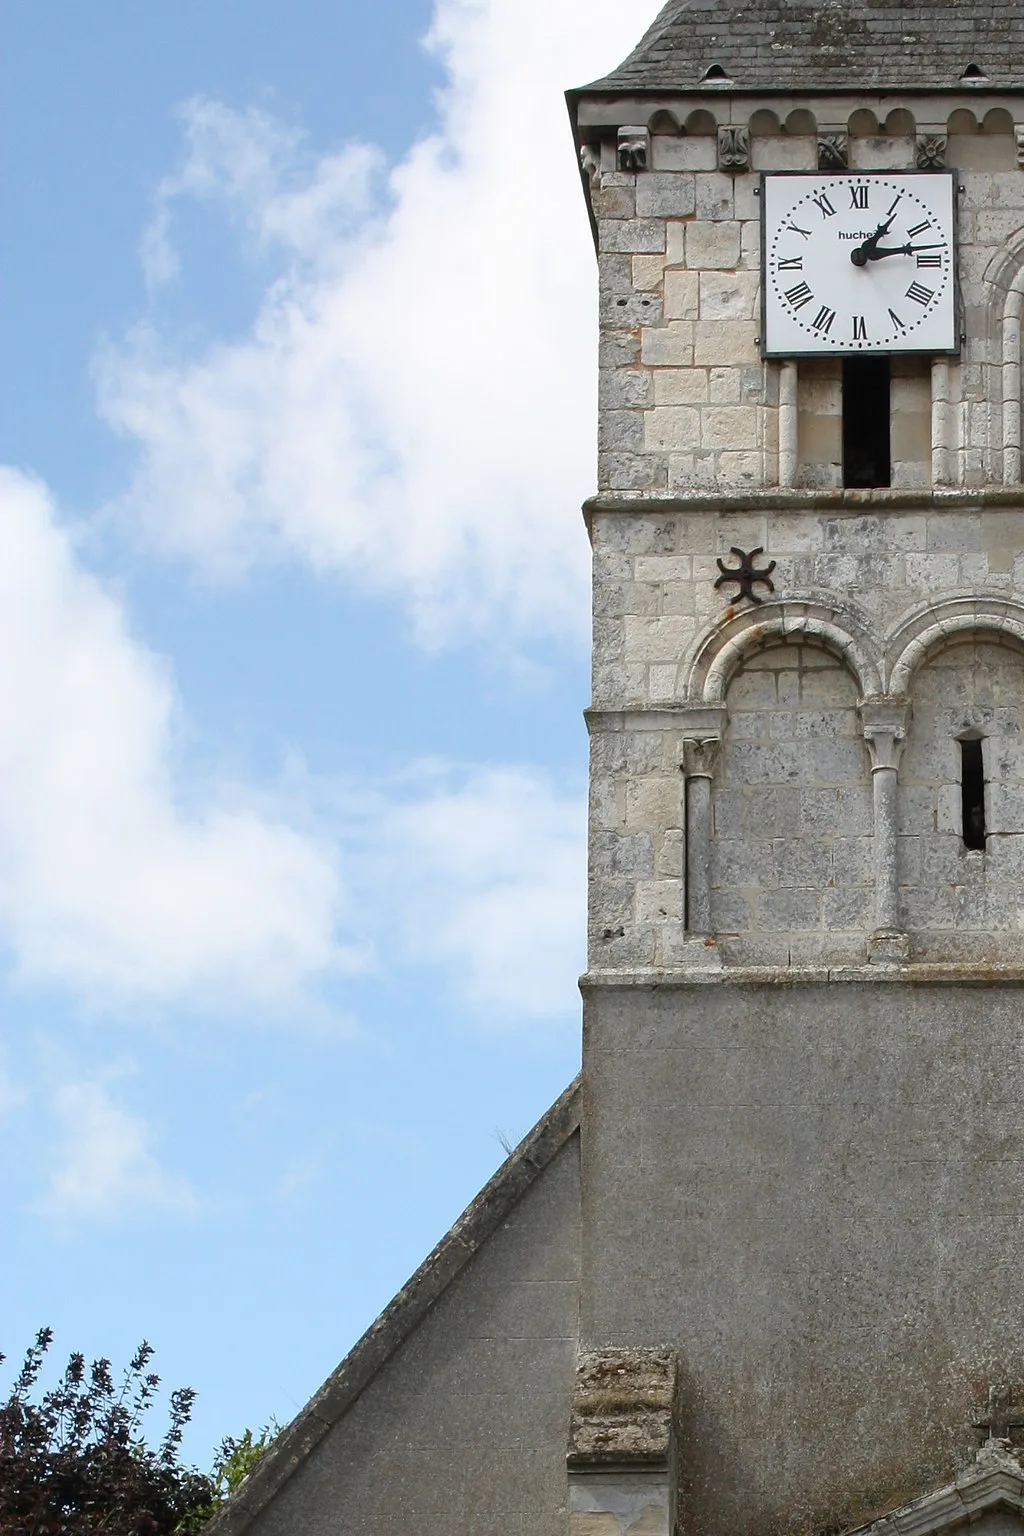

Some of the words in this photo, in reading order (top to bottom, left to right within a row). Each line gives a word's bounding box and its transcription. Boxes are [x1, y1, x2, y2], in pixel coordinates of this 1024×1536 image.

[812, 193, 837, 220] XI
[849, 186, 870, 209] XII
[786, 220, 812, 241] X
[906, 219, 932, 238] II
[777, 256, 803, 271] IX
[916, 254, 942, 269] III
[783, 280, 815, 312] VIII
[904, 280, 936, 308] IIII
[811, 305, 837, 334] VII
[852, 315, 868, 340] VI
[888, 308, 906, 332] V
